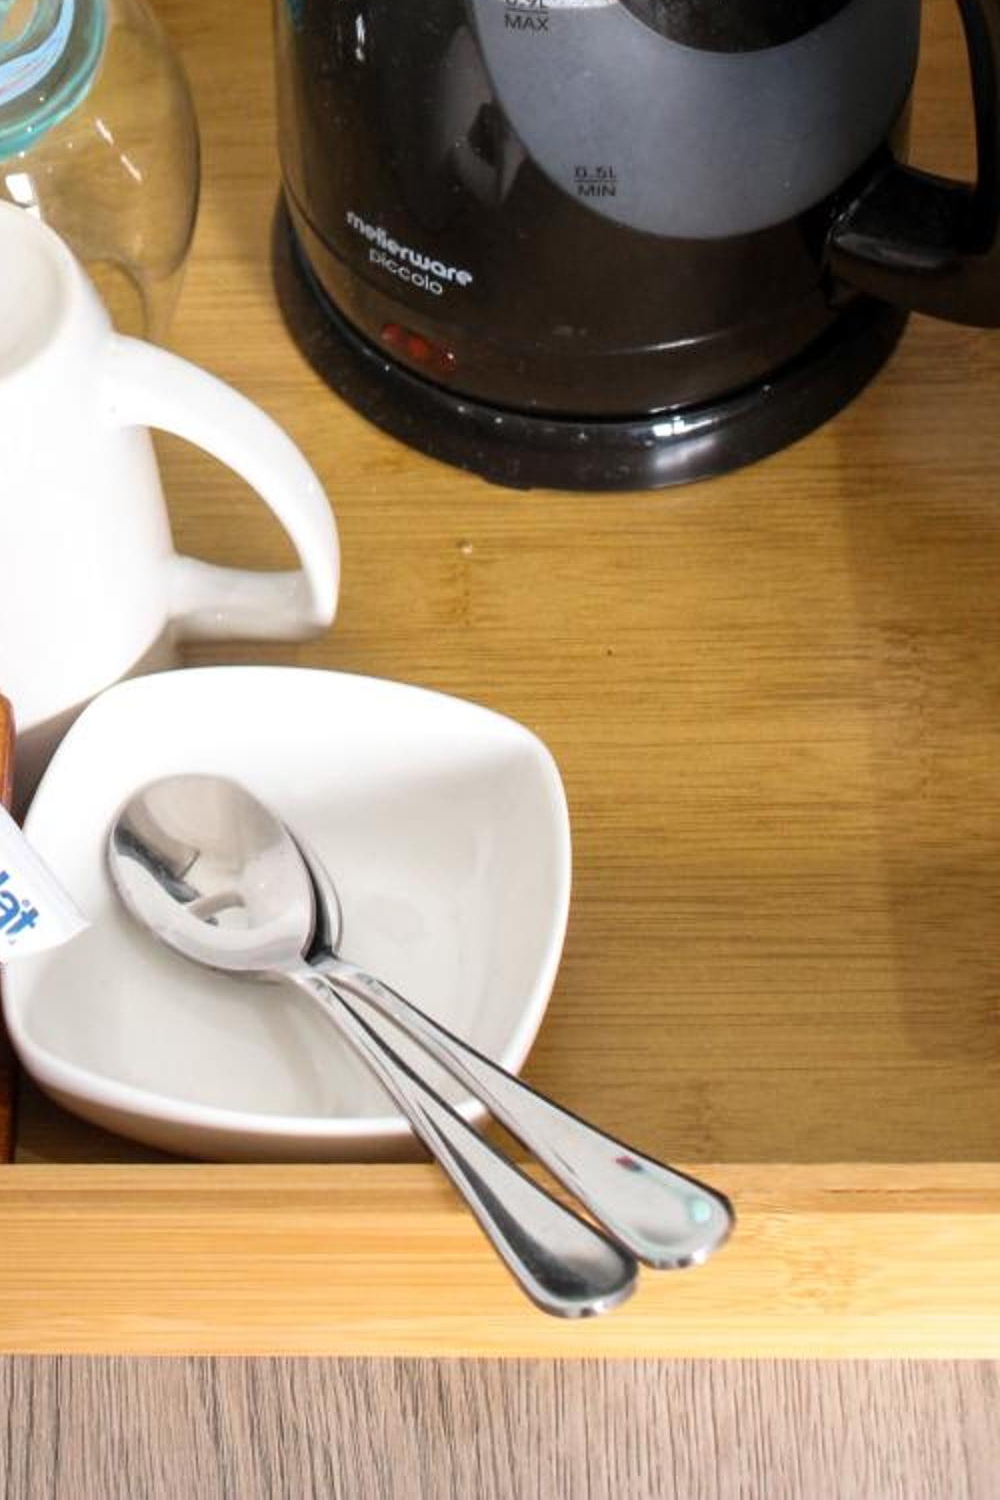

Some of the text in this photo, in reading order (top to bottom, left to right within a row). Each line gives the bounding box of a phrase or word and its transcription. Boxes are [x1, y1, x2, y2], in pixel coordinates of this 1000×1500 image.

[504, 14, 549, 31] MAX
[577, 185, 616, 197] MIN
[346, 211, 472, 286] mellerware
[369, 248, 443, 295] piccolo
